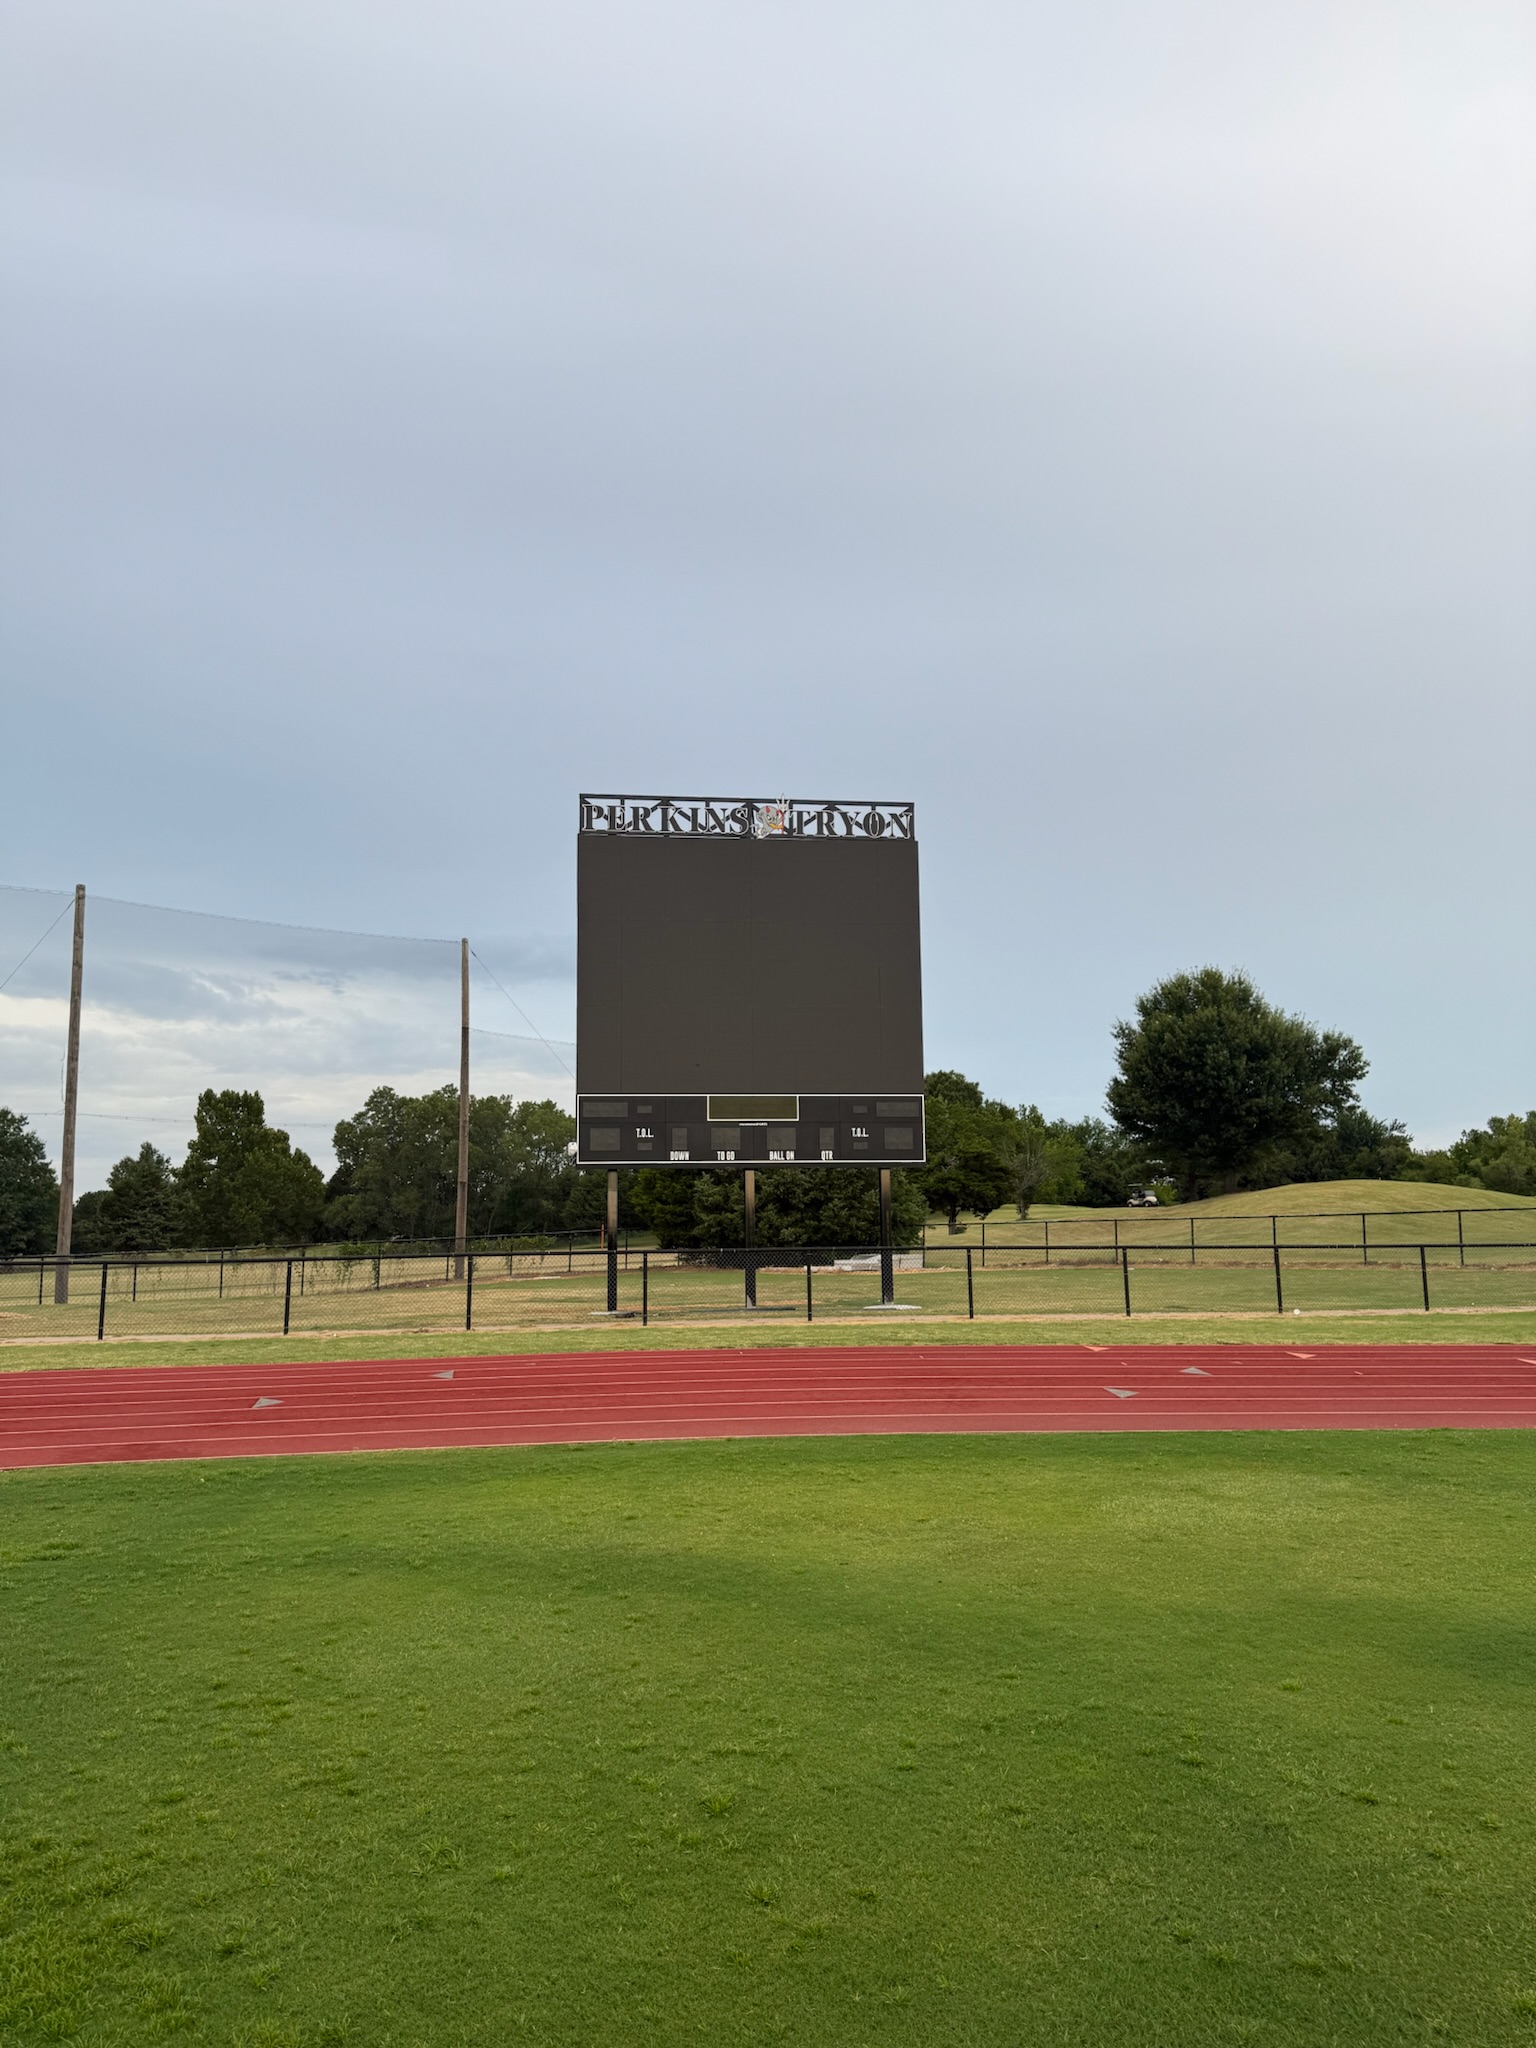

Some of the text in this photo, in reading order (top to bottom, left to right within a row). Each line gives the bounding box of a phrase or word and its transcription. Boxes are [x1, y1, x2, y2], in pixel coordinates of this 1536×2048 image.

[582, 804, 913, 839] PERKINS TRYON
[636, 1128, 654, 1138] T.O.L.
[851, 1127, 869, 1137] T.O.L.
[670, 1151, 690, 1161] DOWN
[717, 1151, 735, 1160] TO GO
[769, 1151, 795, 1160] BALL ON
[821, 1151, 833, 1160] QTR
